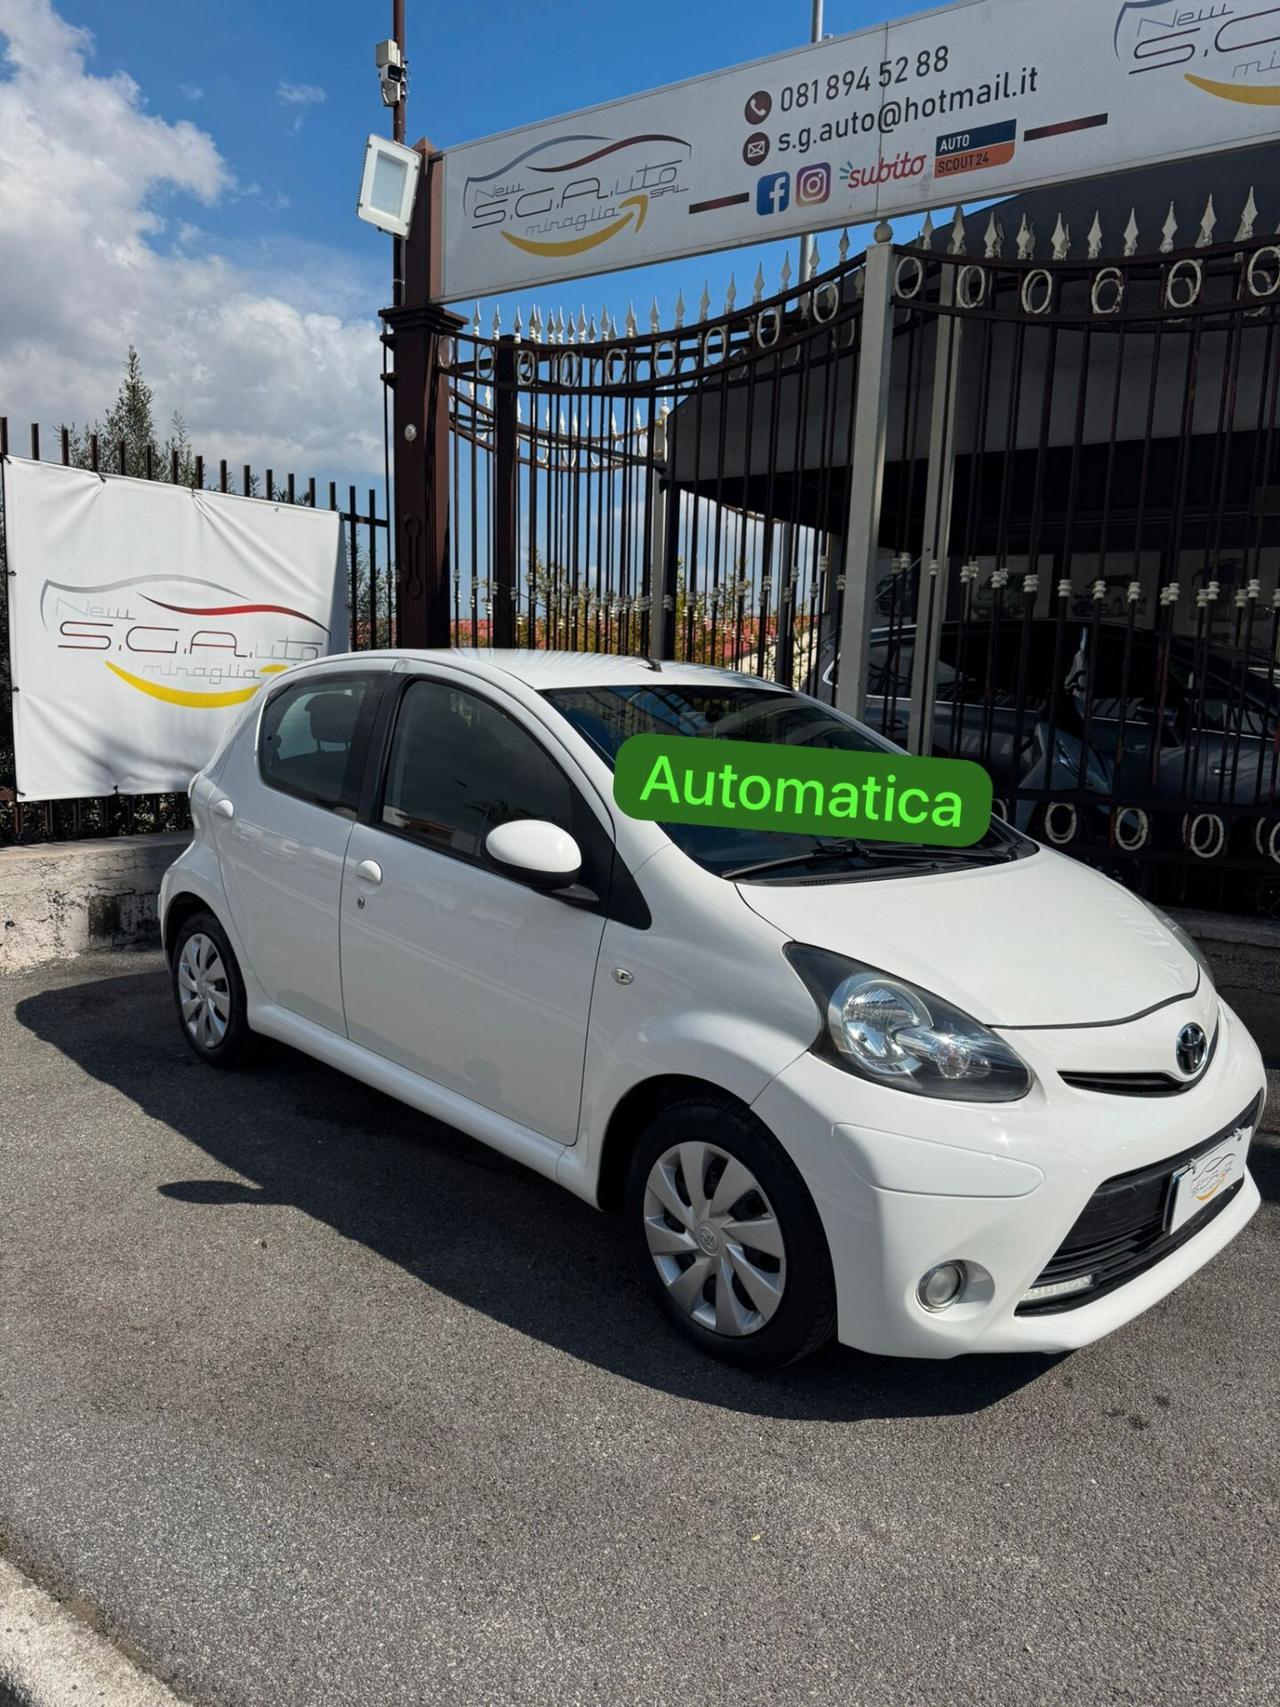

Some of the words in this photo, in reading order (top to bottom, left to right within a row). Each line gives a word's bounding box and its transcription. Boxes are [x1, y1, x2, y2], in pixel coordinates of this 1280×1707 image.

[780, 79, 819, 112] 081
[826, 66, 870, 101] 894
[878, 56, 909, 88] 52
[916, 45, 949, 77] 88
[778, 66, 1039, 153] s.g.auto@hotmail.it
[938, 134, 971, 153] AUTO
[847, 151, 928, 189] subito
